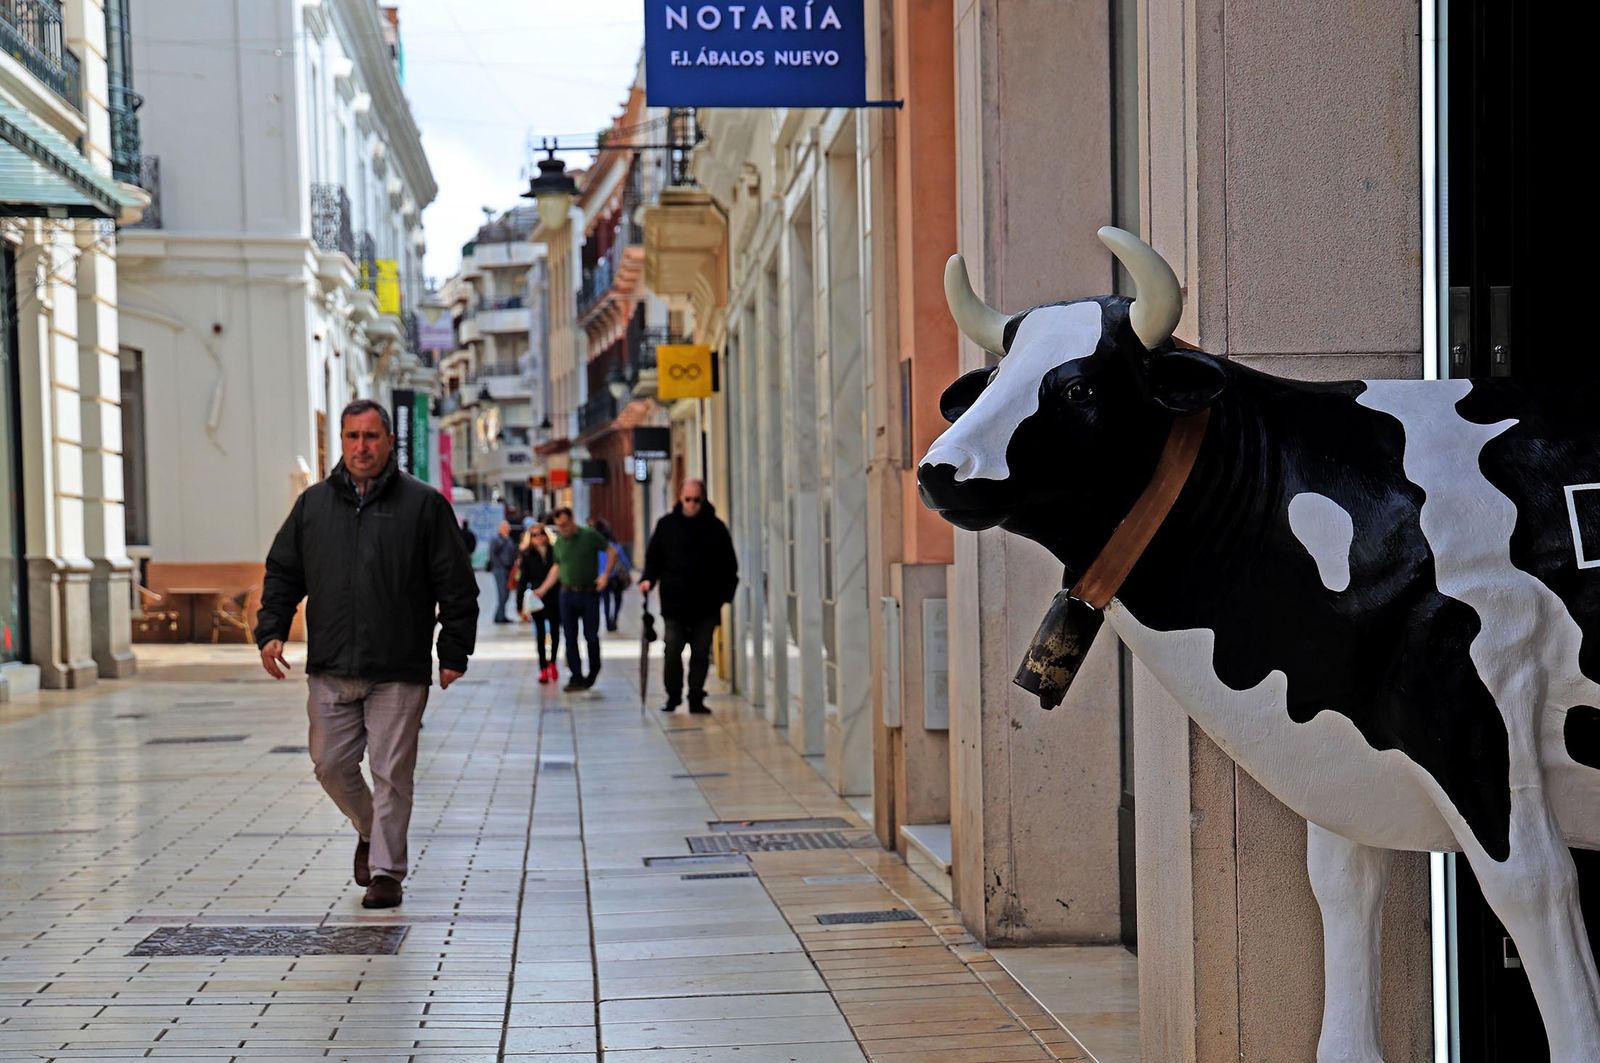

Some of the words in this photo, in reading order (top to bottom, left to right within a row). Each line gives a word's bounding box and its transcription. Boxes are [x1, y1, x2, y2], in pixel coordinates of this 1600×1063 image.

[665, 0, 842, 31] NOTARÍA
[670, 50, 692, 66] F.J.
[695, 46, 765, 66] ÁBALOS
[774, 49, 840, 66] NUEVO
